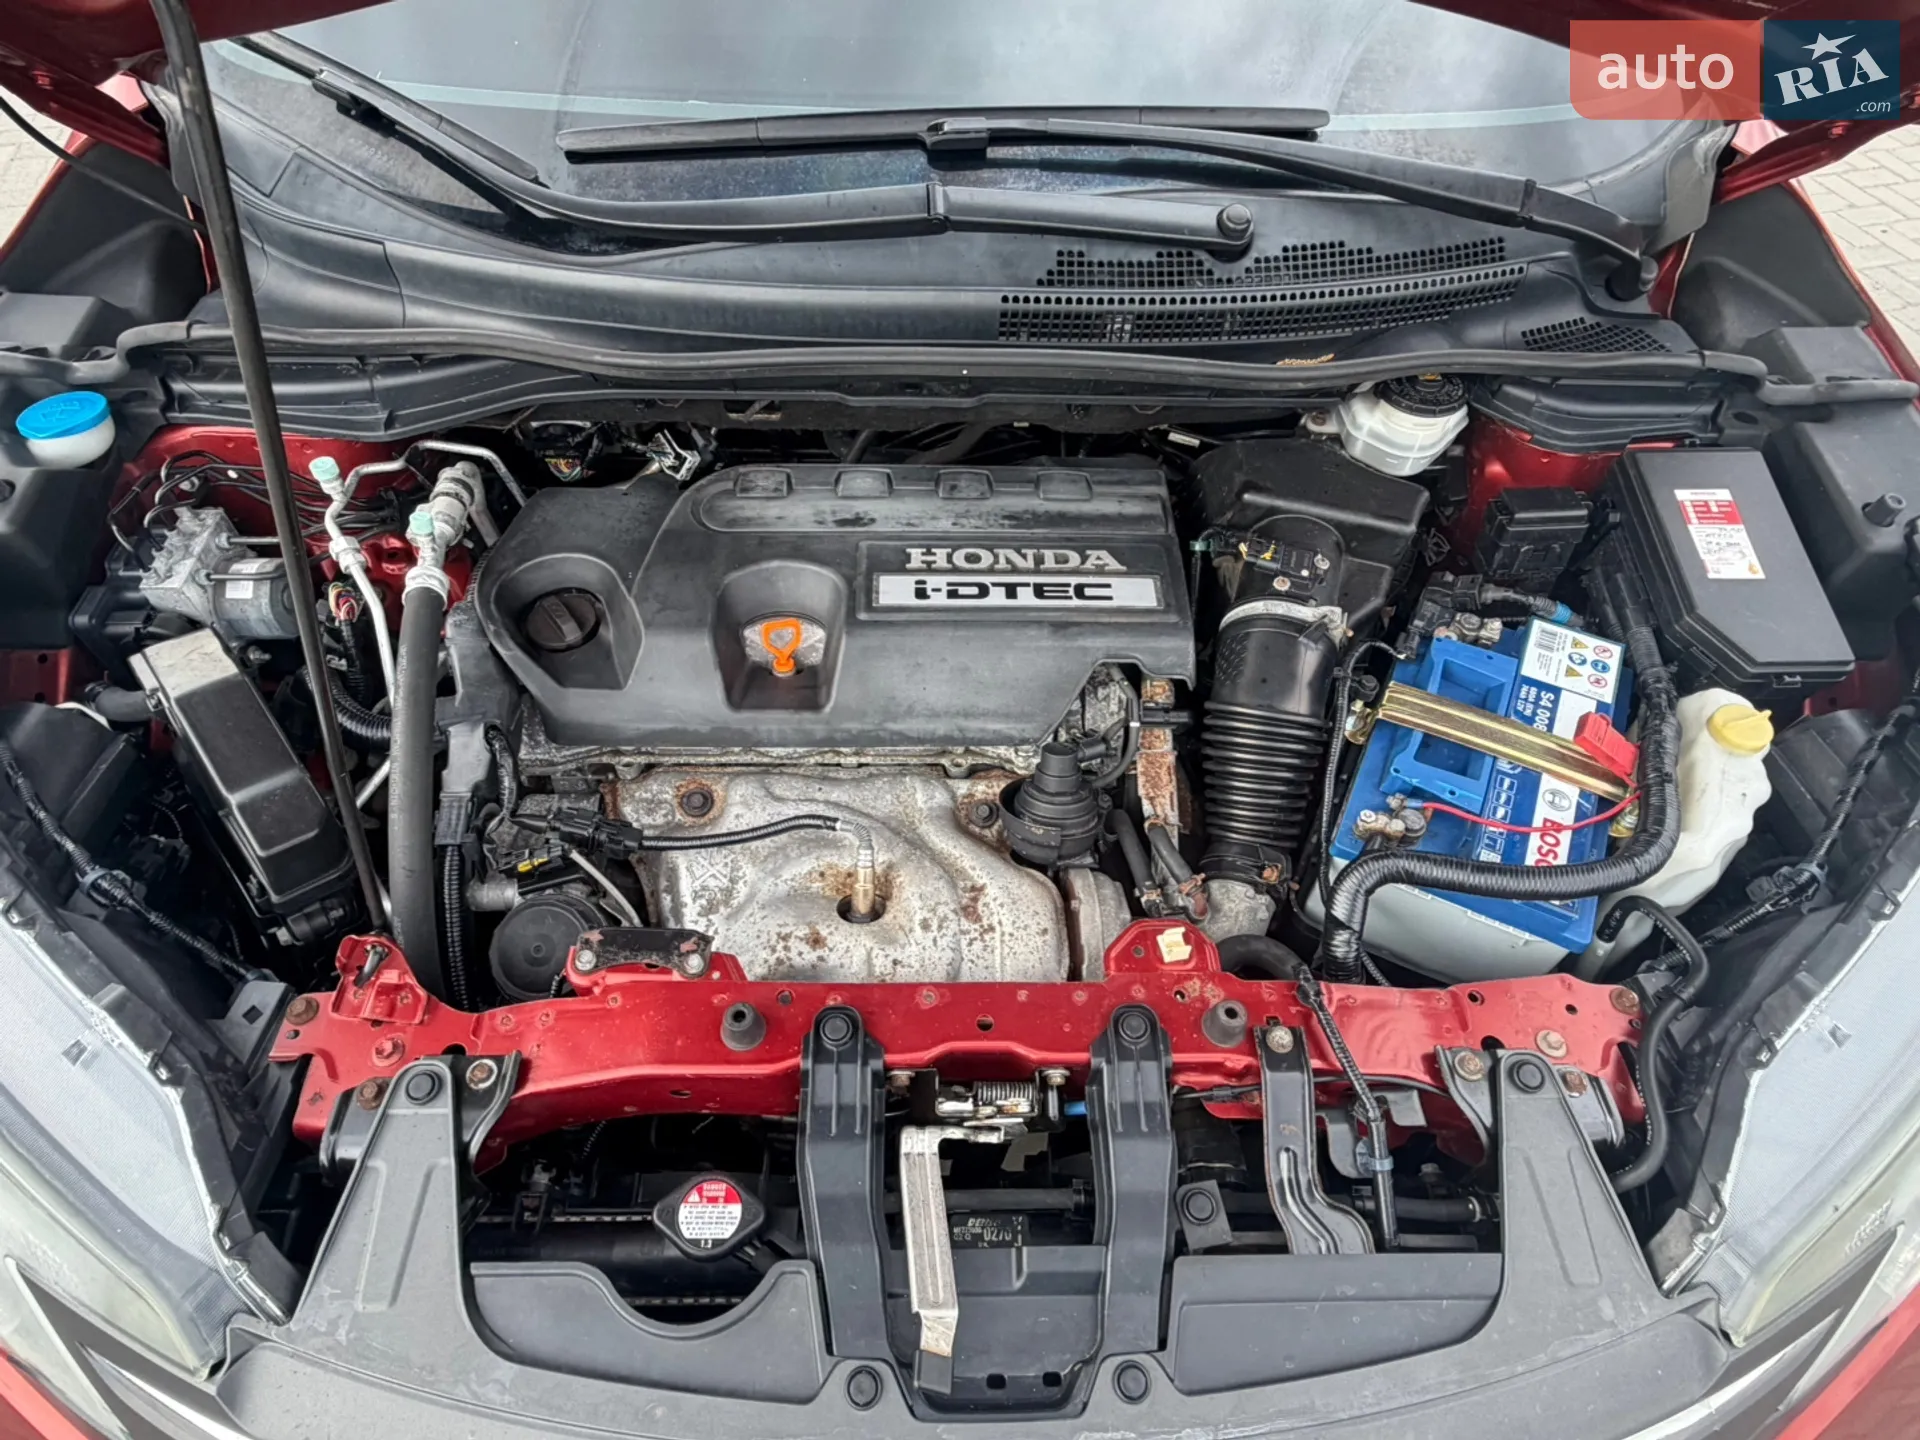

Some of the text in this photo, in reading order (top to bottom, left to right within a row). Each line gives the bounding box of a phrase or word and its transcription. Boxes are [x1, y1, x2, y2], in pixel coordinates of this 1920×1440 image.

[905, 547, 1128, 572] HONDA
[914, 579, 1114, 601] i-DTEC
[1538, 690, 1555, 708] S4
[1534, 816, 1564, 868] BOSC
